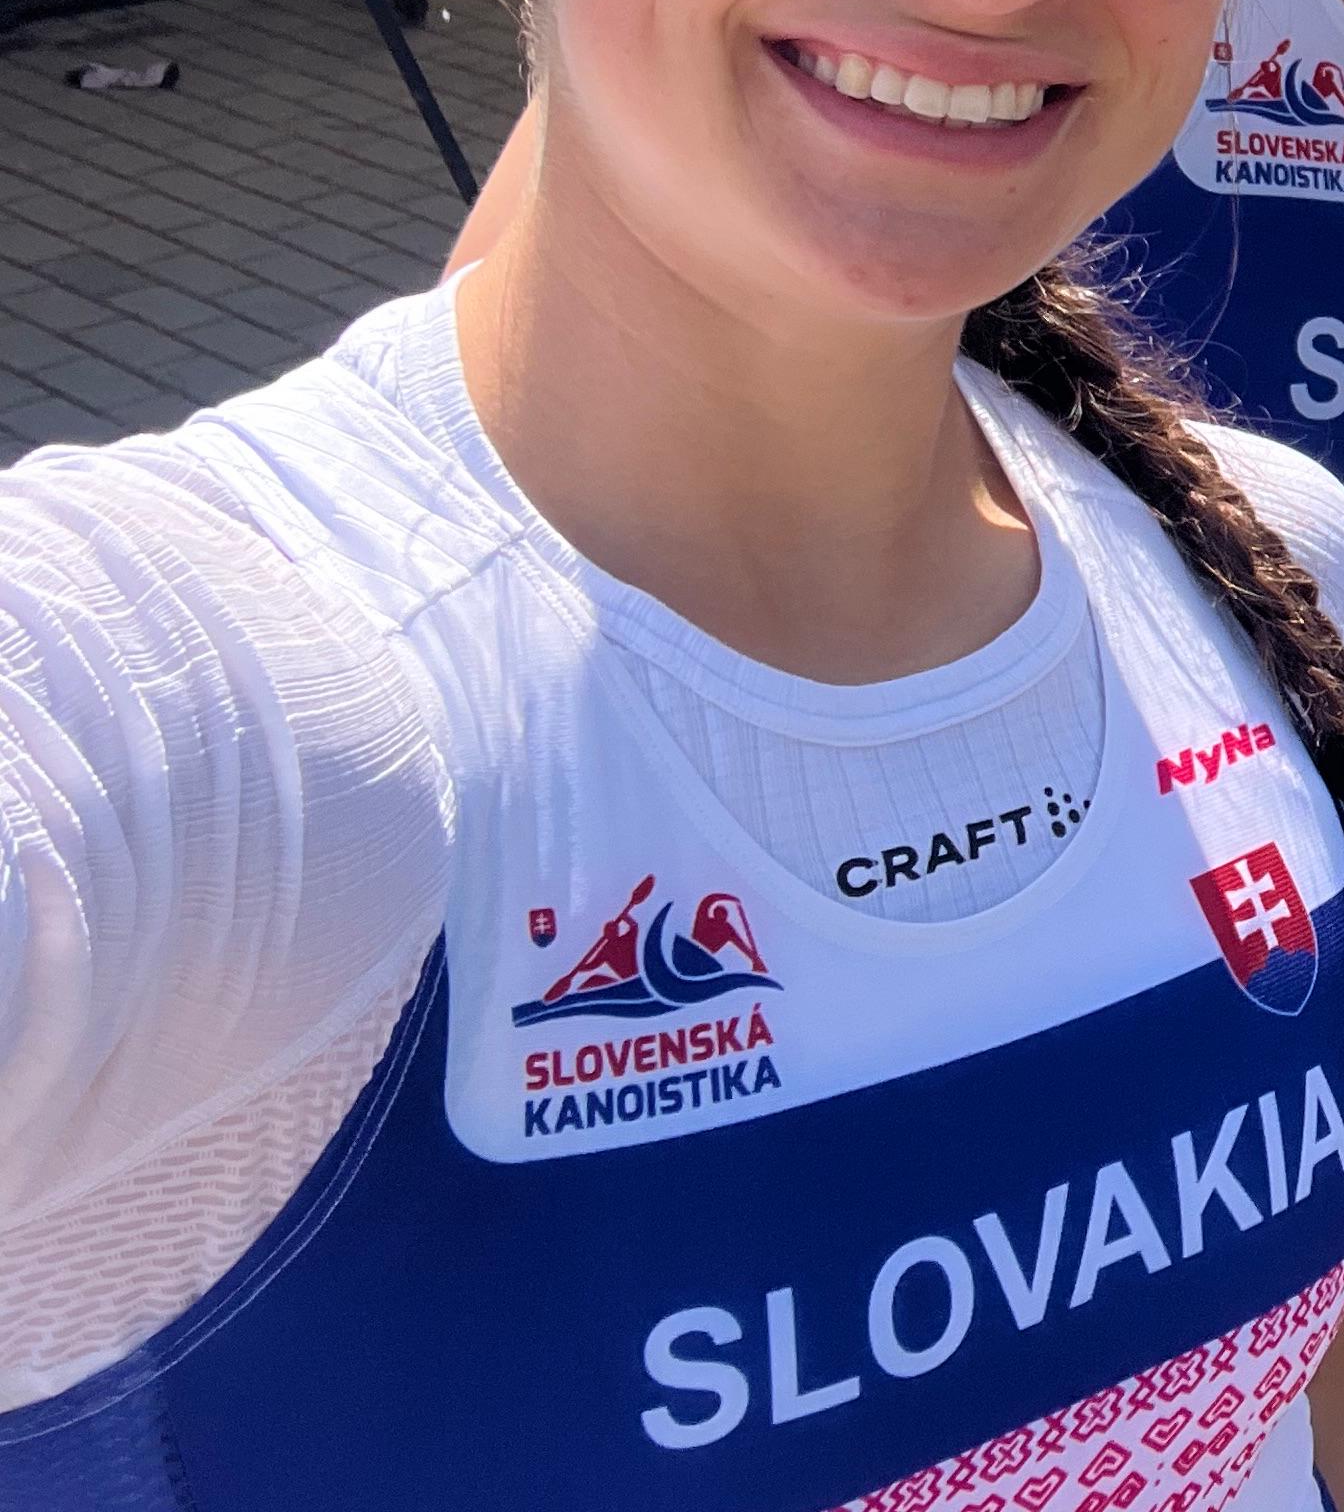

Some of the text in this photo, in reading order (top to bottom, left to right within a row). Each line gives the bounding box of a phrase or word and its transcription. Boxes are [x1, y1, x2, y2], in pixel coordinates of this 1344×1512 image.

[1155, 720, 1277, 796] NyNa
[835, 804, 1036, 898] CRAFT
[523, 1001, 776, 1092] SLOVENSKÁ
[522, 1054, 783, 1139] KANOISTIKA
